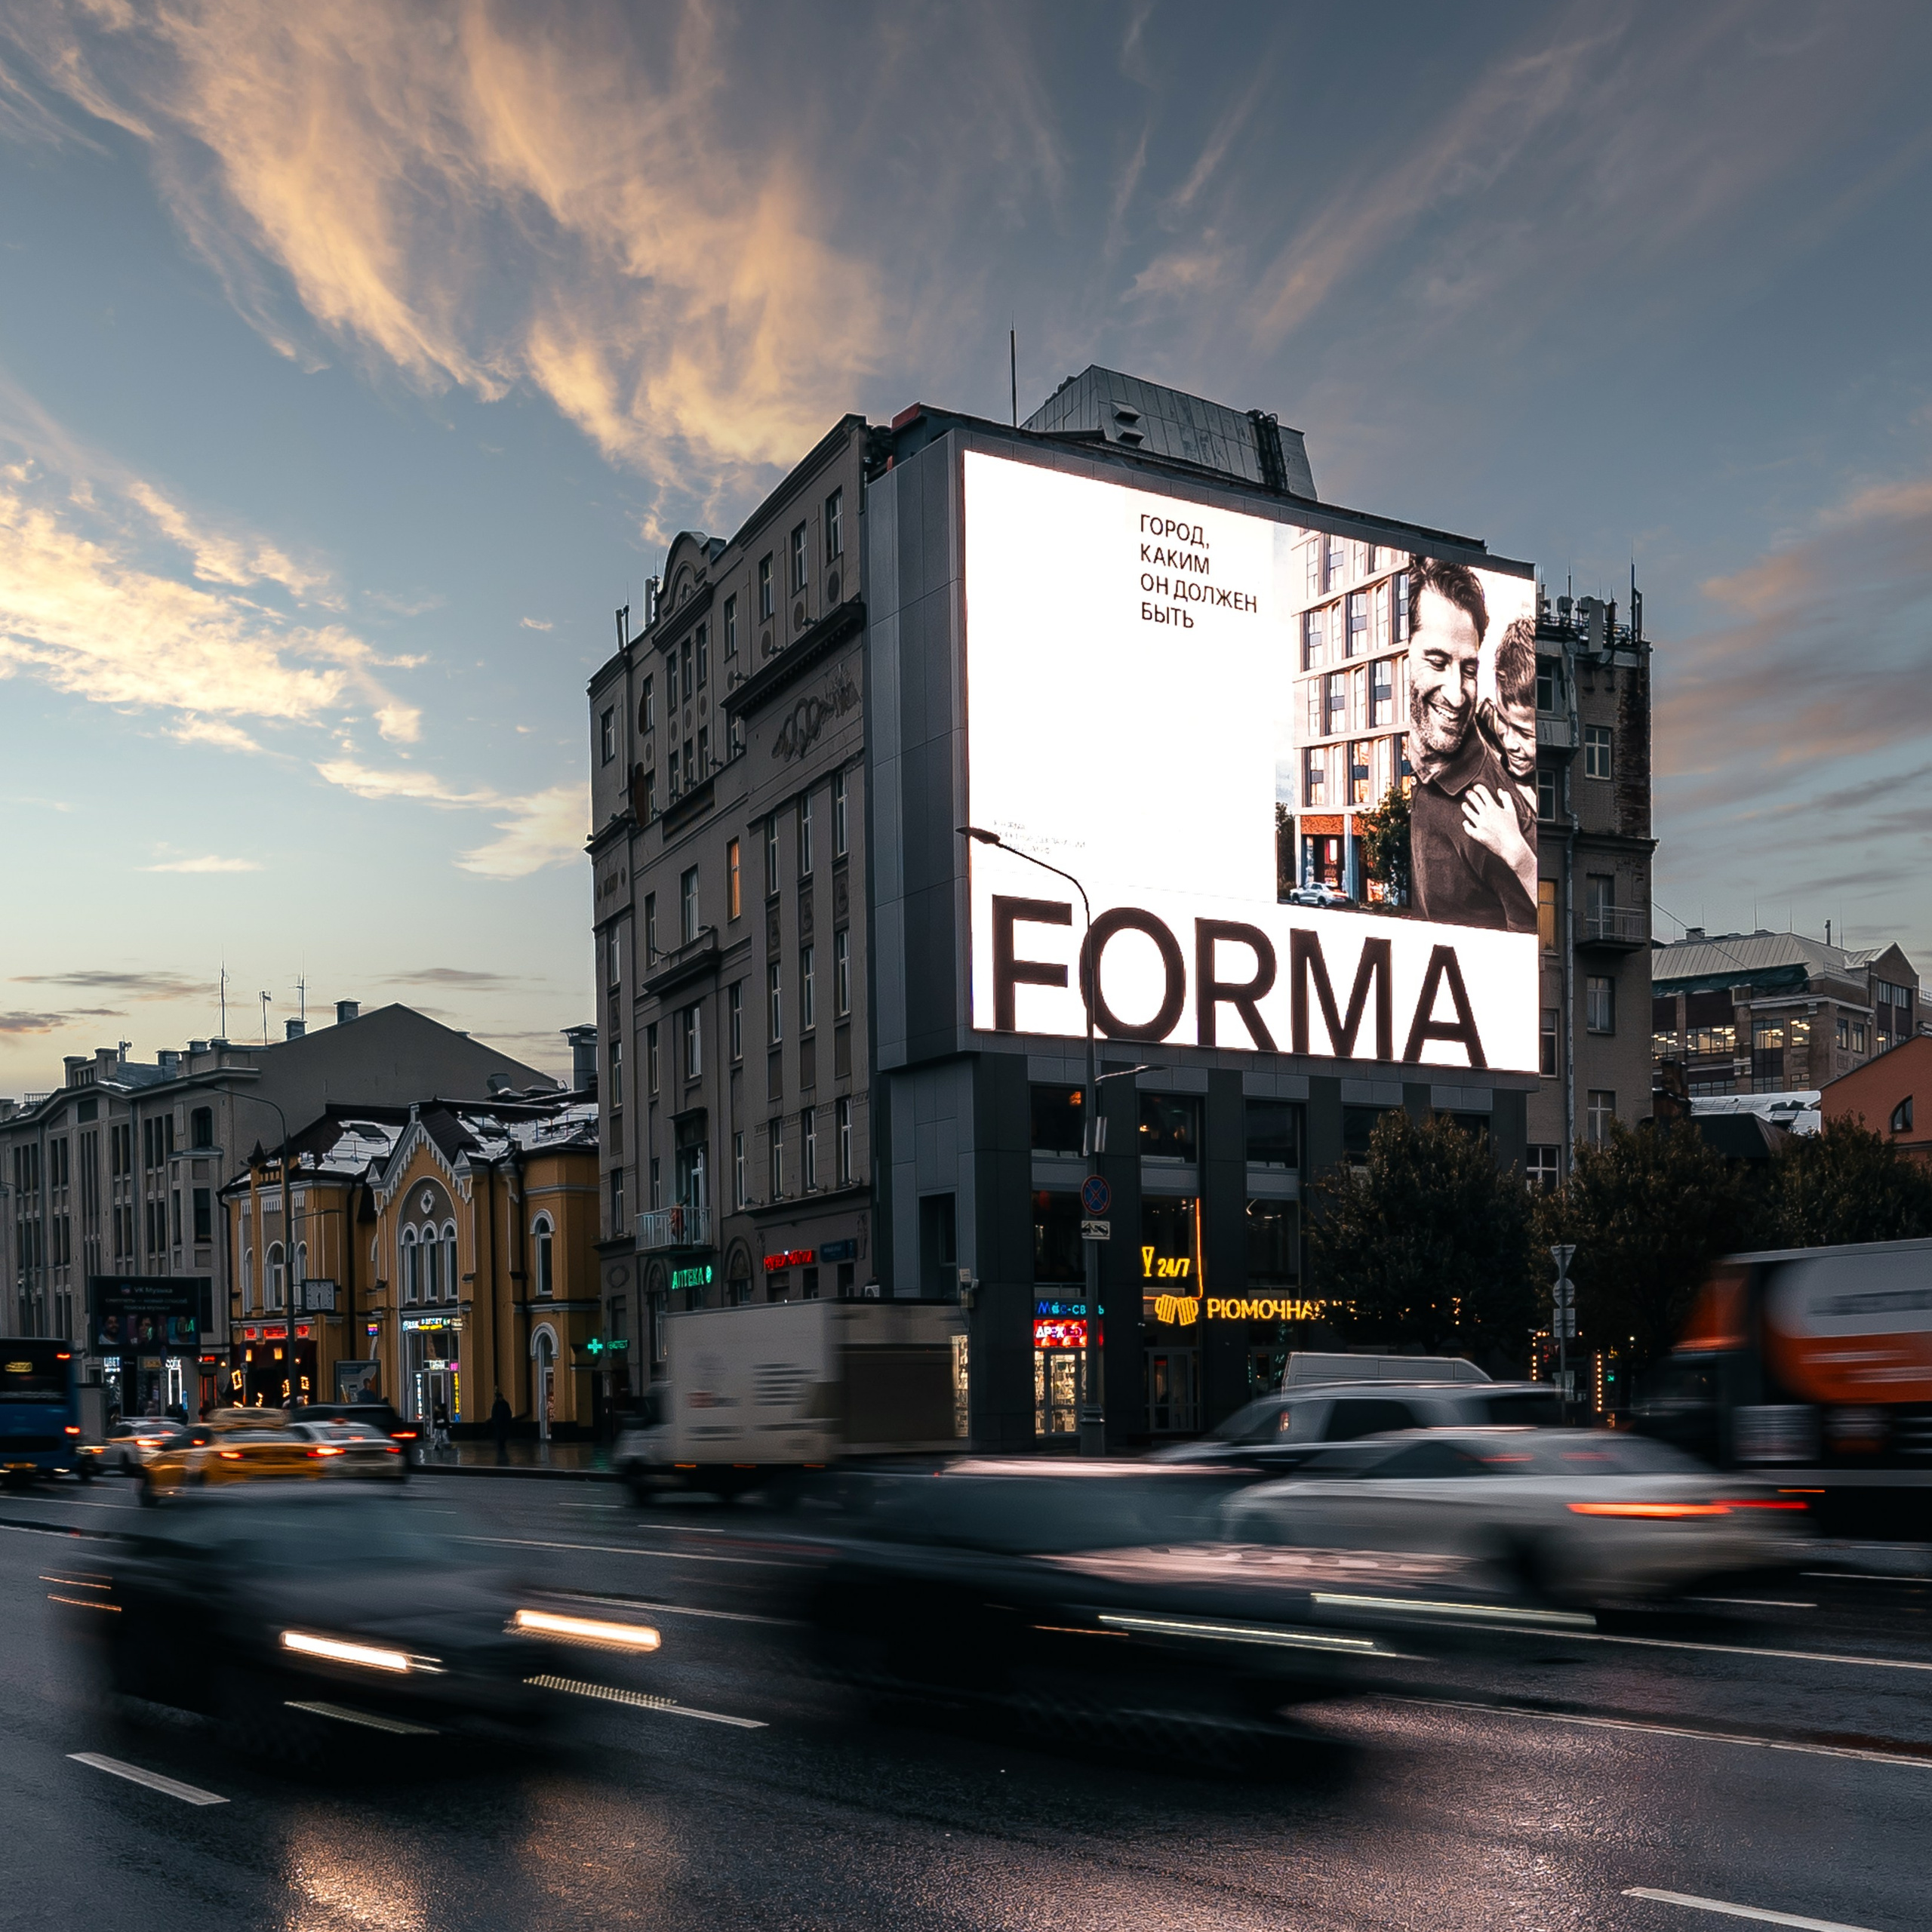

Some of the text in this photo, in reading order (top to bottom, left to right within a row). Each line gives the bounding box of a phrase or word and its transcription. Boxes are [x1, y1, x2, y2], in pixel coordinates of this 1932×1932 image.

[1140, 514, 1211, 549] ГОРОД,
[1140, 544, 1210, 575] КАКИМ
[1140, 574, 1258, 614] ОН ДОЛЖЕН
[1140, 601, 1195, 629] БЫТЬ
[992, 894, 1488, 1068] FORMA
[672, 1268, 704, 1290] АПТЕКА
[1157, 1258, 1191, 1277] 24/7
